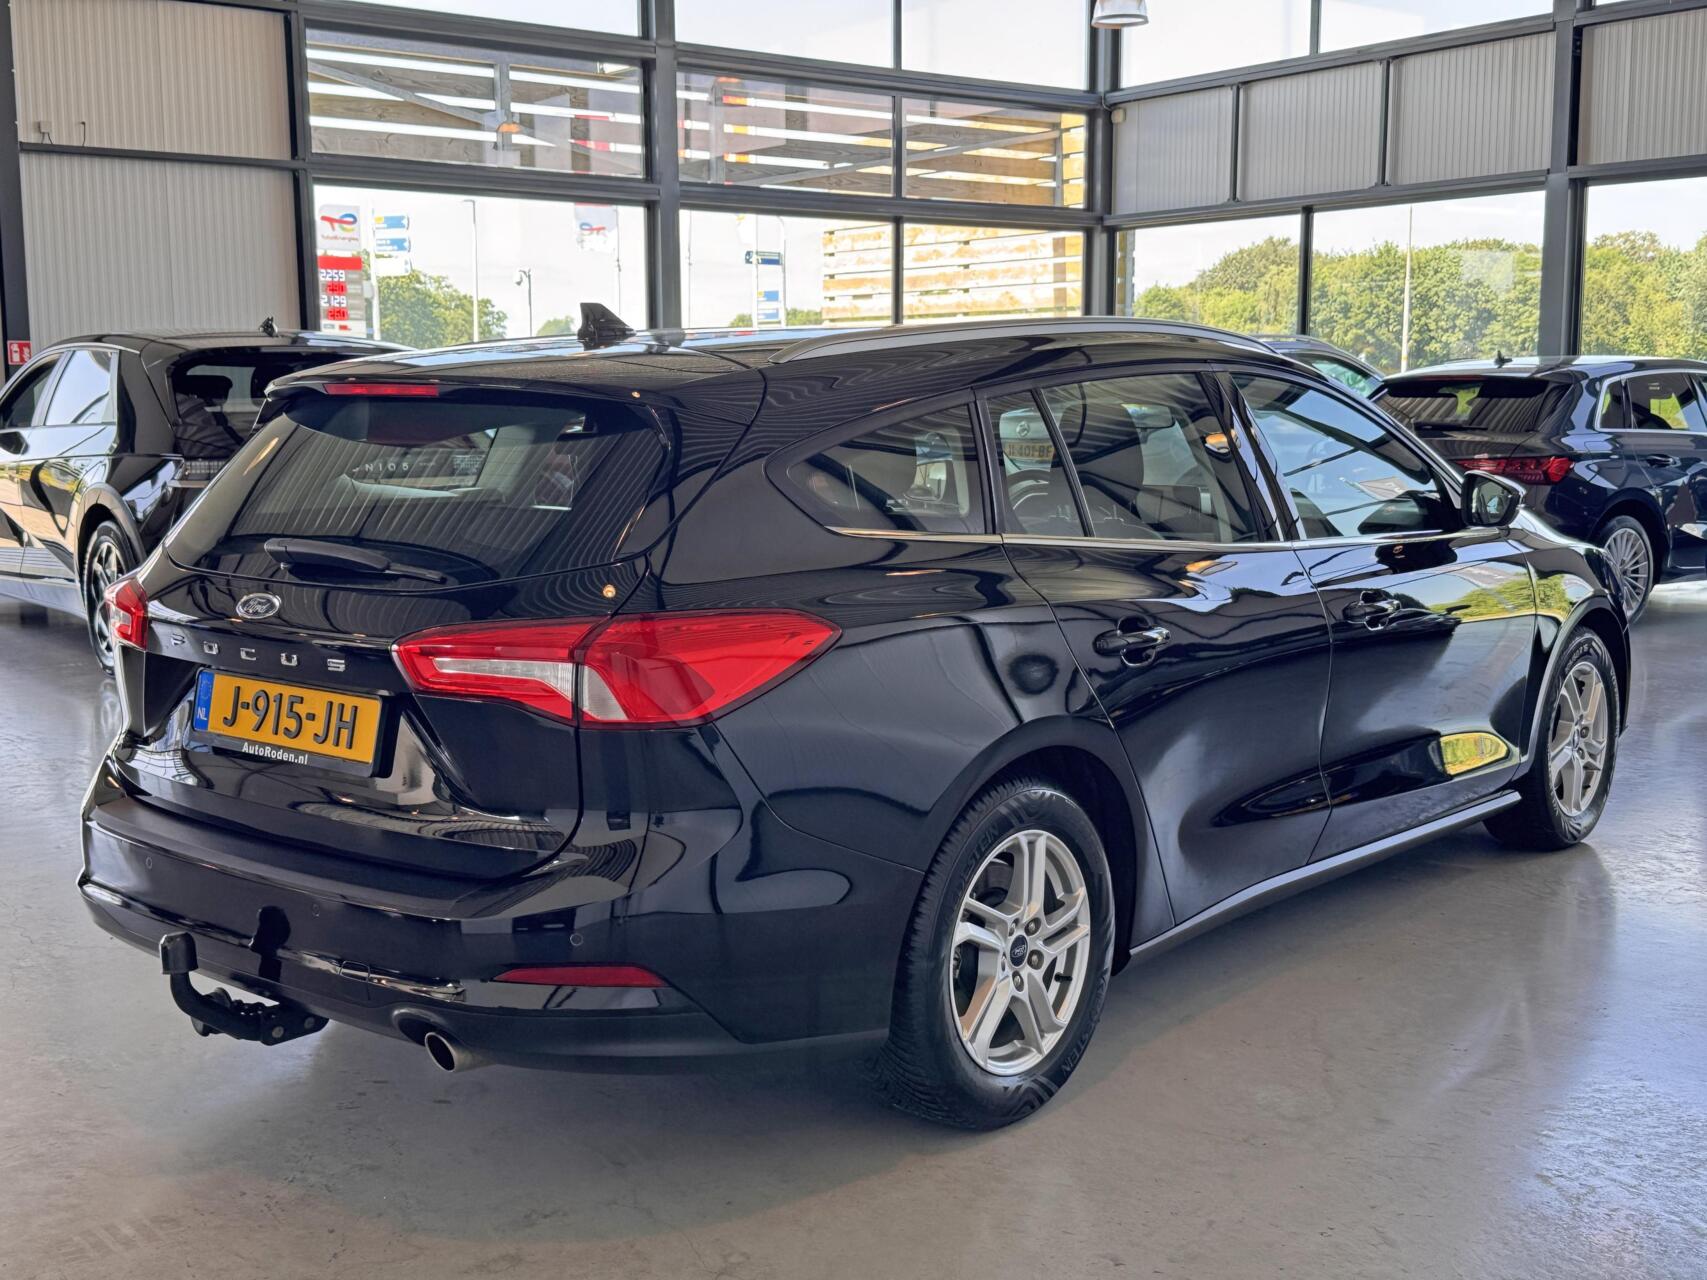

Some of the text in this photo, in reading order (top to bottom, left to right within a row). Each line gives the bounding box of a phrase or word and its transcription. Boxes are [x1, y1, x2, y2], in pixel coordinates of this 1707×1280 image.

[243, 597, 271, 613] Ford
[171, 633, 346, 672] FOCUS
[197, 706, 208, 721] NL
[222, 686, 358, 750] J-915-JH
[241, 742, 308, 765] AutoRoden.nl
